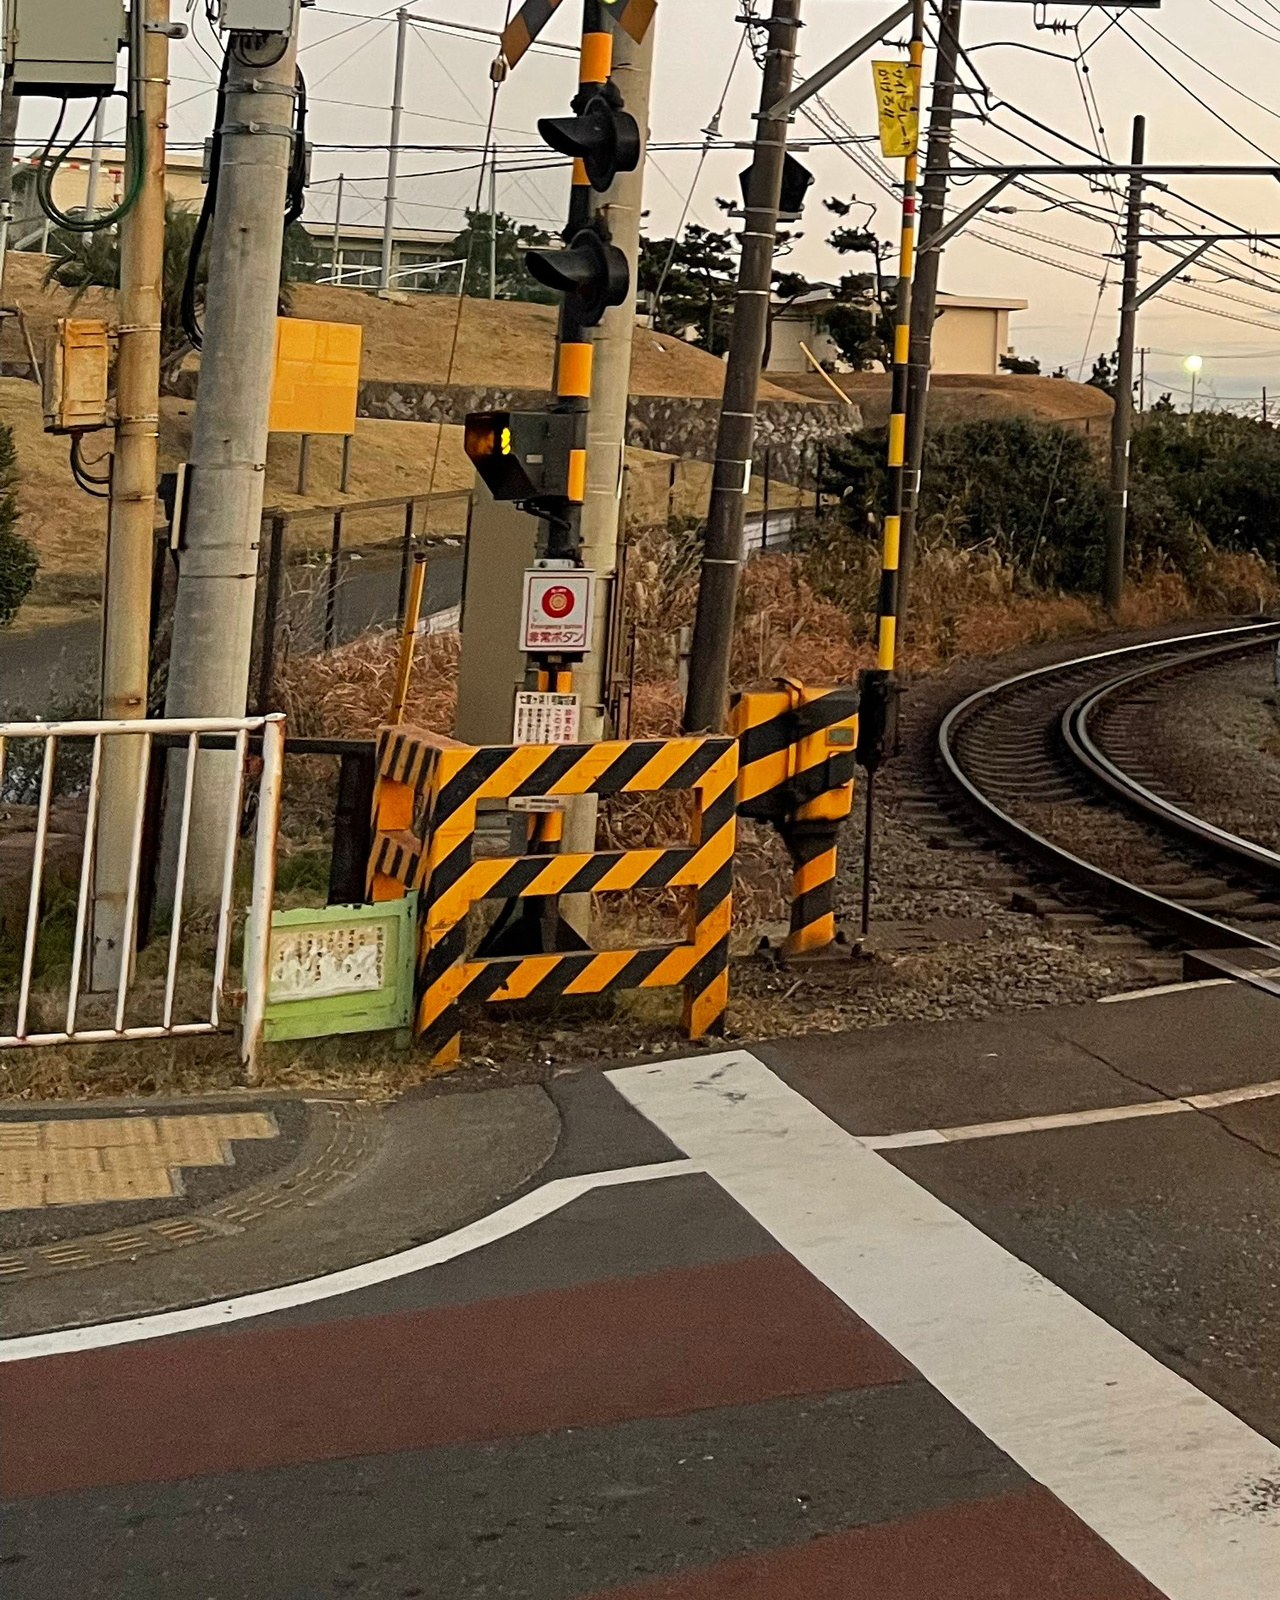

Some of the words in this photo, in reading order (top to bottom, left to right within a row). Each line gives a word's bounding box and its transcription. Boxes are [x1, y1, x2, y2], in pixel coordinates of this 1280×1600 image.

[528, 632, 584, 643] 非常ボタン
